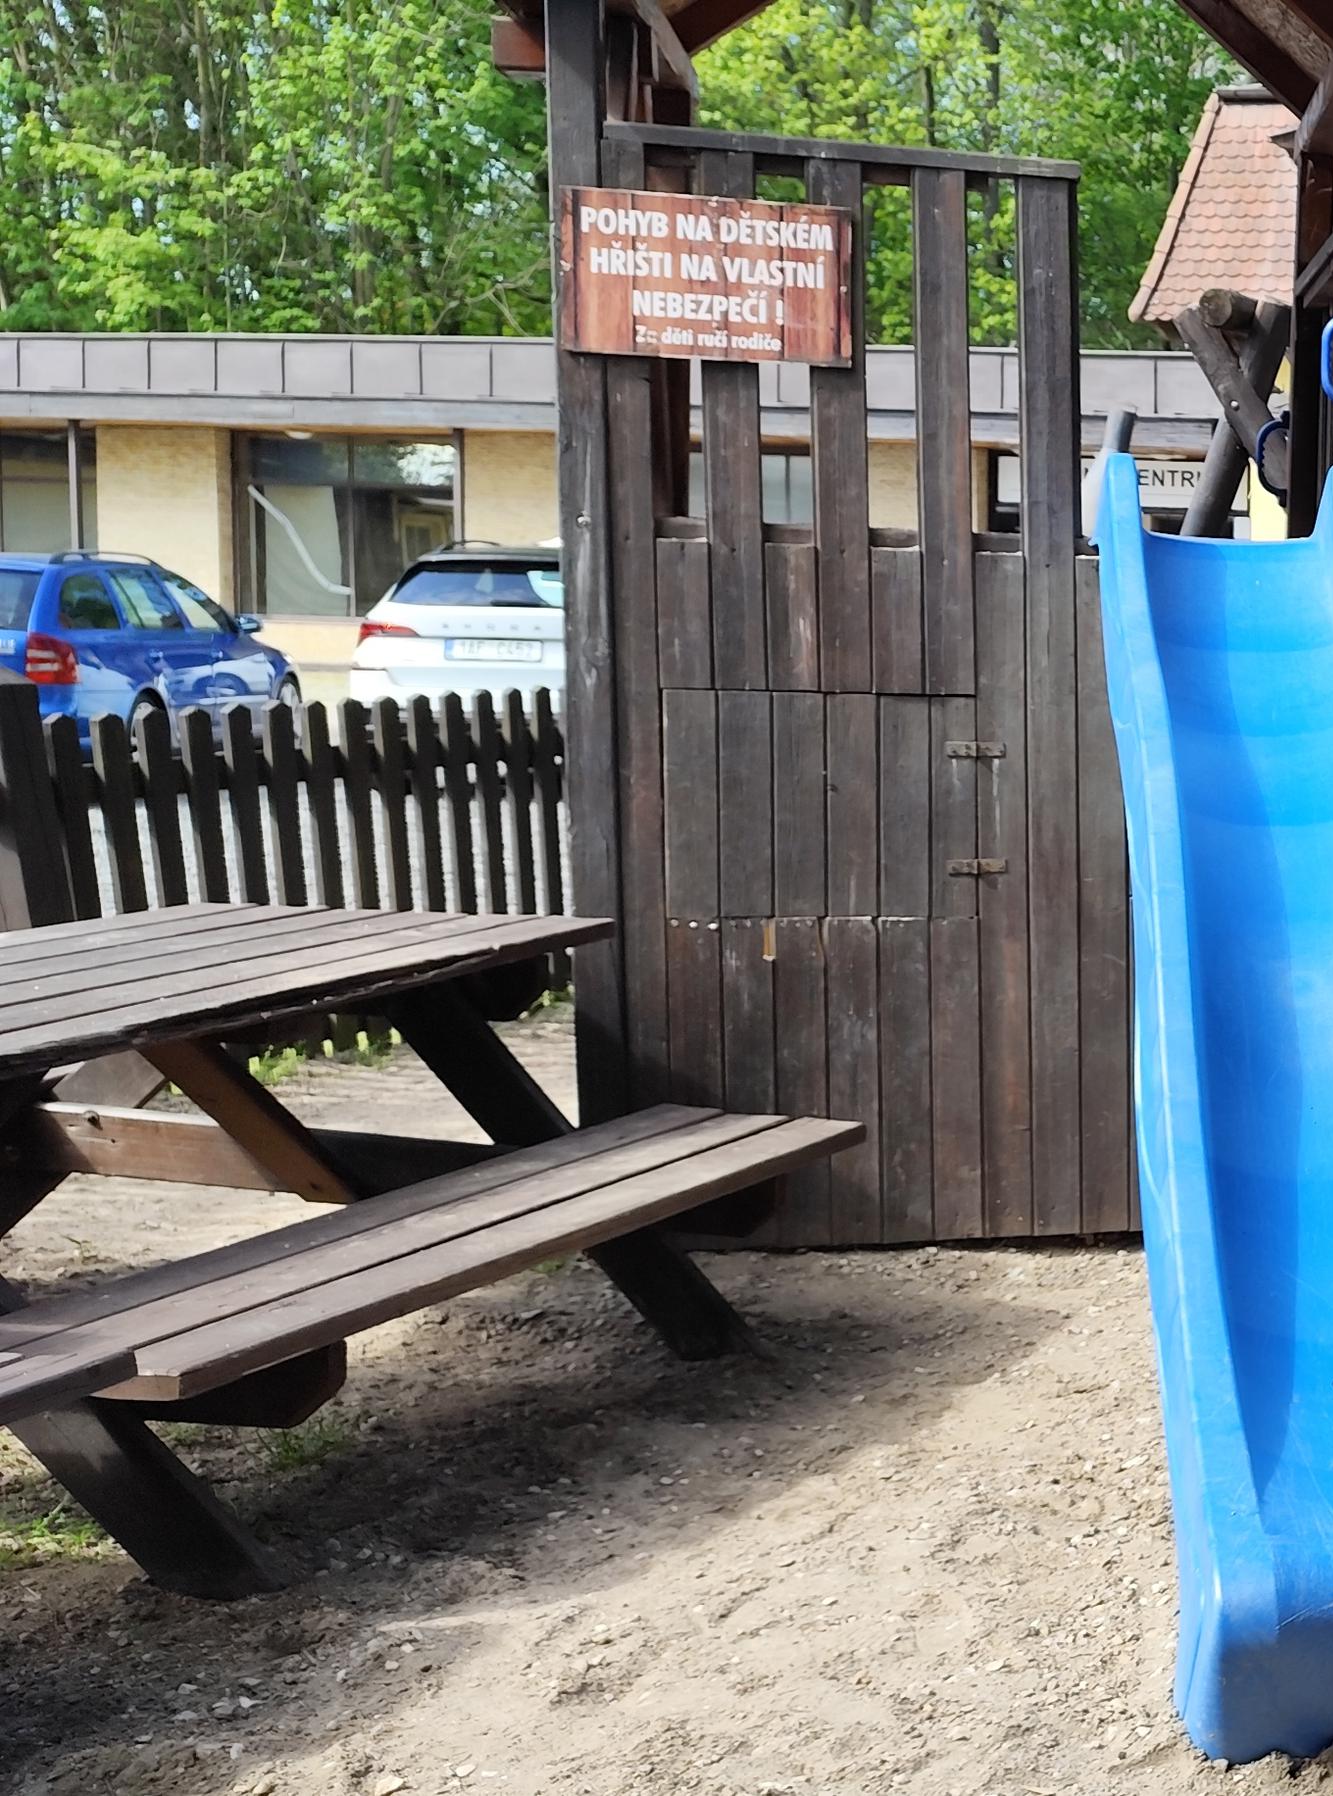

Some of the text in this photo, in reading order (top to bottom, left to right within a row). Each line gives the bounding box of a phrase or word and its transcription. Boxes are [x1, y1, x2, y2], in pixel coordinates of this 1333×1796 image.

[580, 206, 834, 251] POHYB NA DĚTSKÉM
[590, 240, 825, 289] HŘIŠTI NA VLASTNÍ
[633, 289, 784, 326] NEBEZPEČÍ !
[660, 325, 694, 346] děti
[697, 329, 728, 348] ručí
[730, 331, 782, 352] rodiče
[1138, 467, 1201, 488] ENTR
